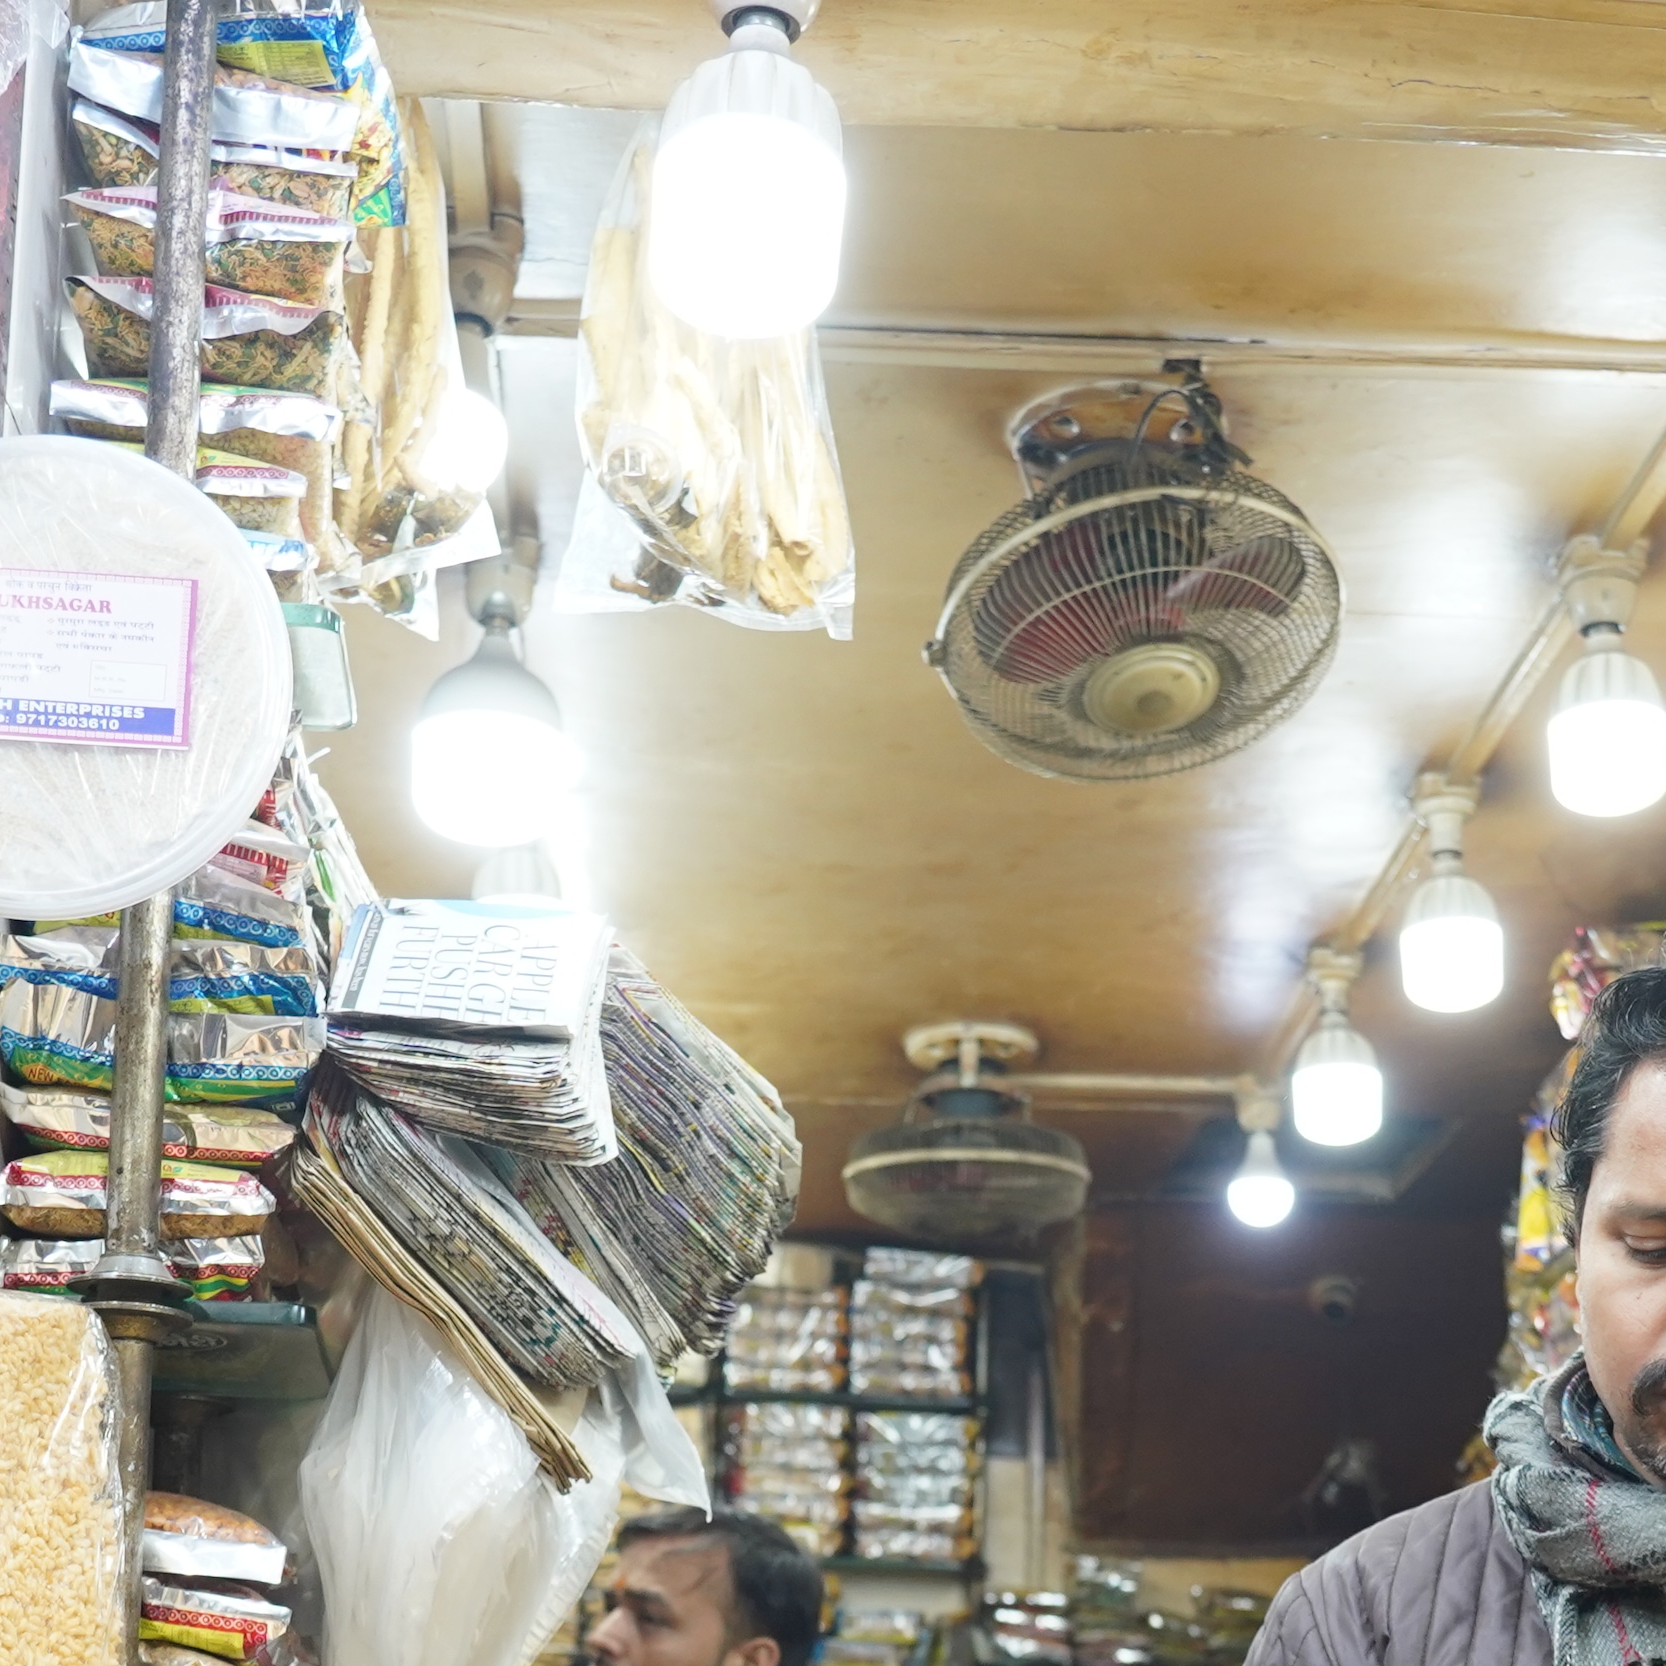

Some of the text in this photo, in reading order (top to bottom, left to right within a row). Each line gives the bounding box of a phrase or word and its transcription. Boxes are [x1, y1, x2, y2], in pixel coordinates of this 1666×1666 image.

[16, 713, 120, 731] 9717303610
[19, 700, 146, 719] ENTERPRISES
[378, 925, 441, 1012] FURTH
[473, 924, 522, 978] CAR
[507, 936, 560, 1024] APPLE
[28, 1068, 54, 1082] NEW
